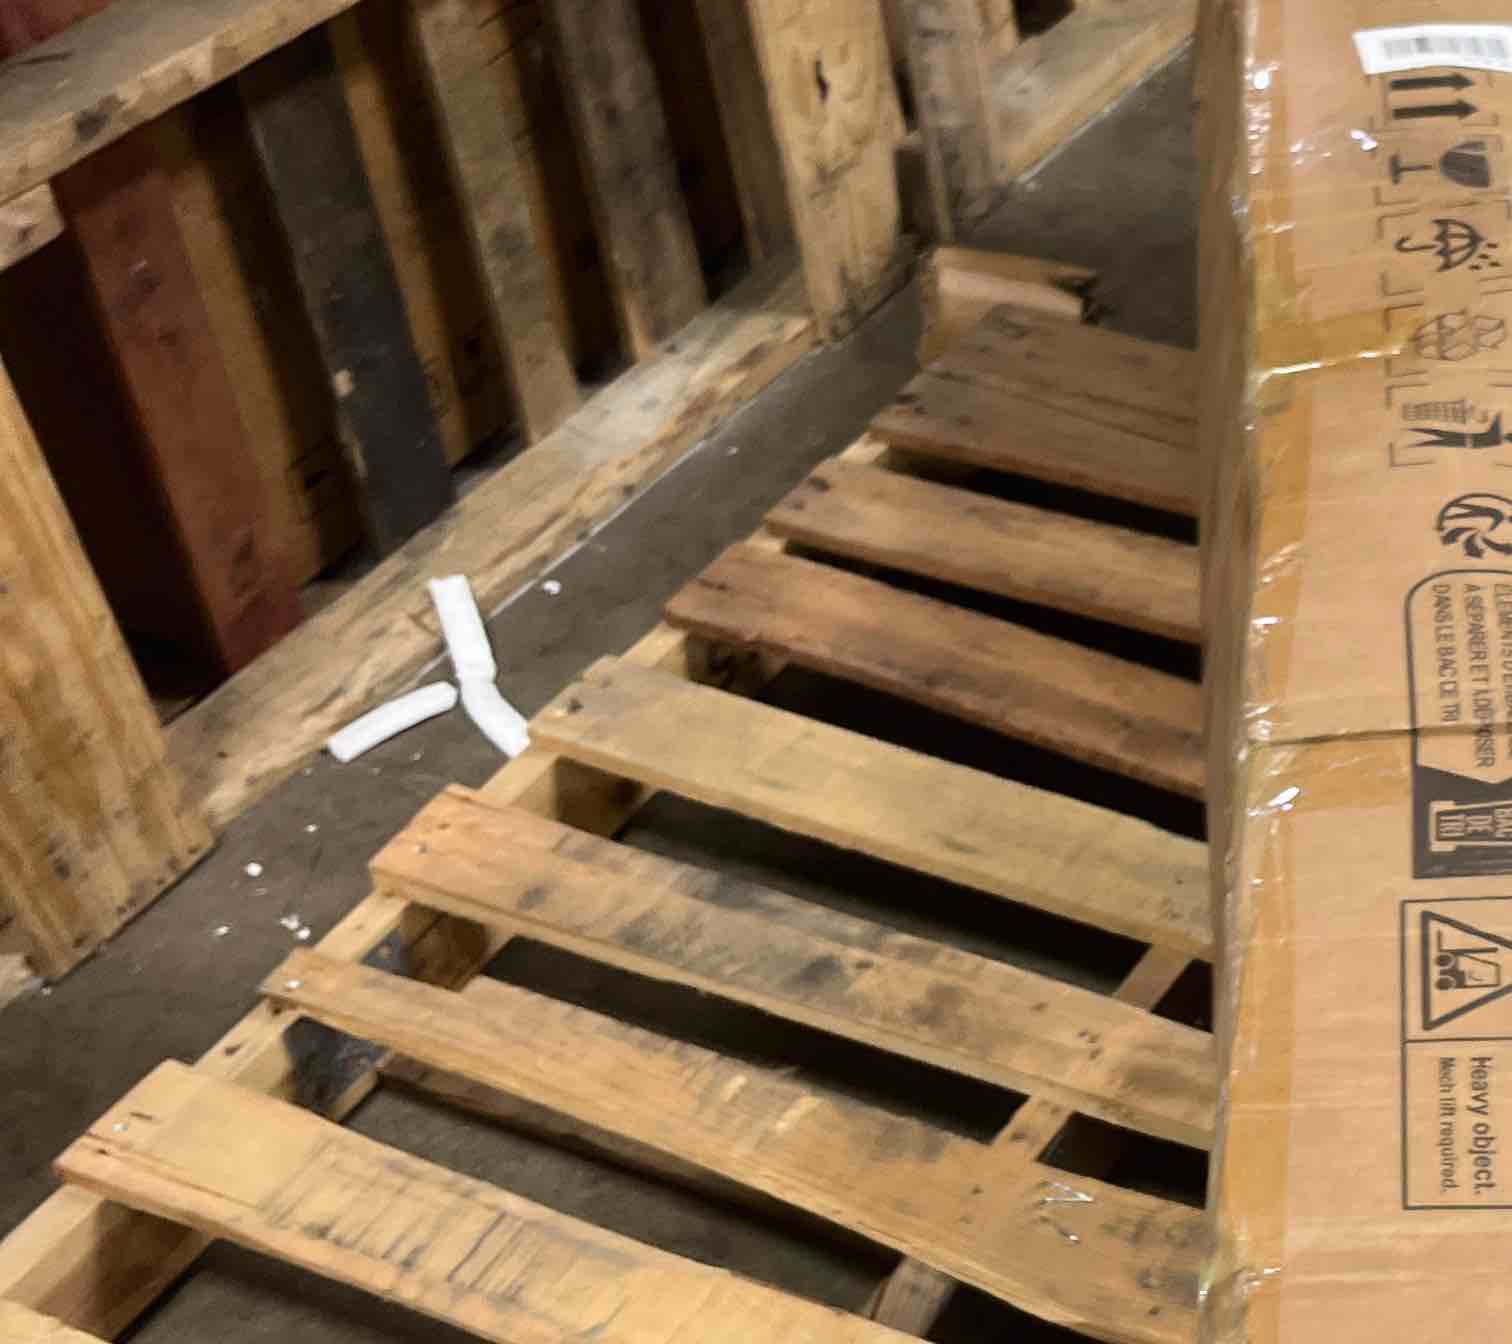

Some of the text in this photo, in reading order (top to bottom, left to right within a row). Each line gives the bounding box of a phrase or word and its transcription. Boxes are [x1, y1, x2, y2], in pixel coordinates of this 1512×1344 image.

[1433, 584, 1462, 722] DANS LE BAC DE TRI
[1469, 666, 1491, 683] ET
[1439, 815, 1465, 837] TRI
[1466, 815, 1493, 833] DE
[1437, 1057, 1461, 1193] Mech lift required.
[1467, 1056, 1498, 1195] Heavy object.
